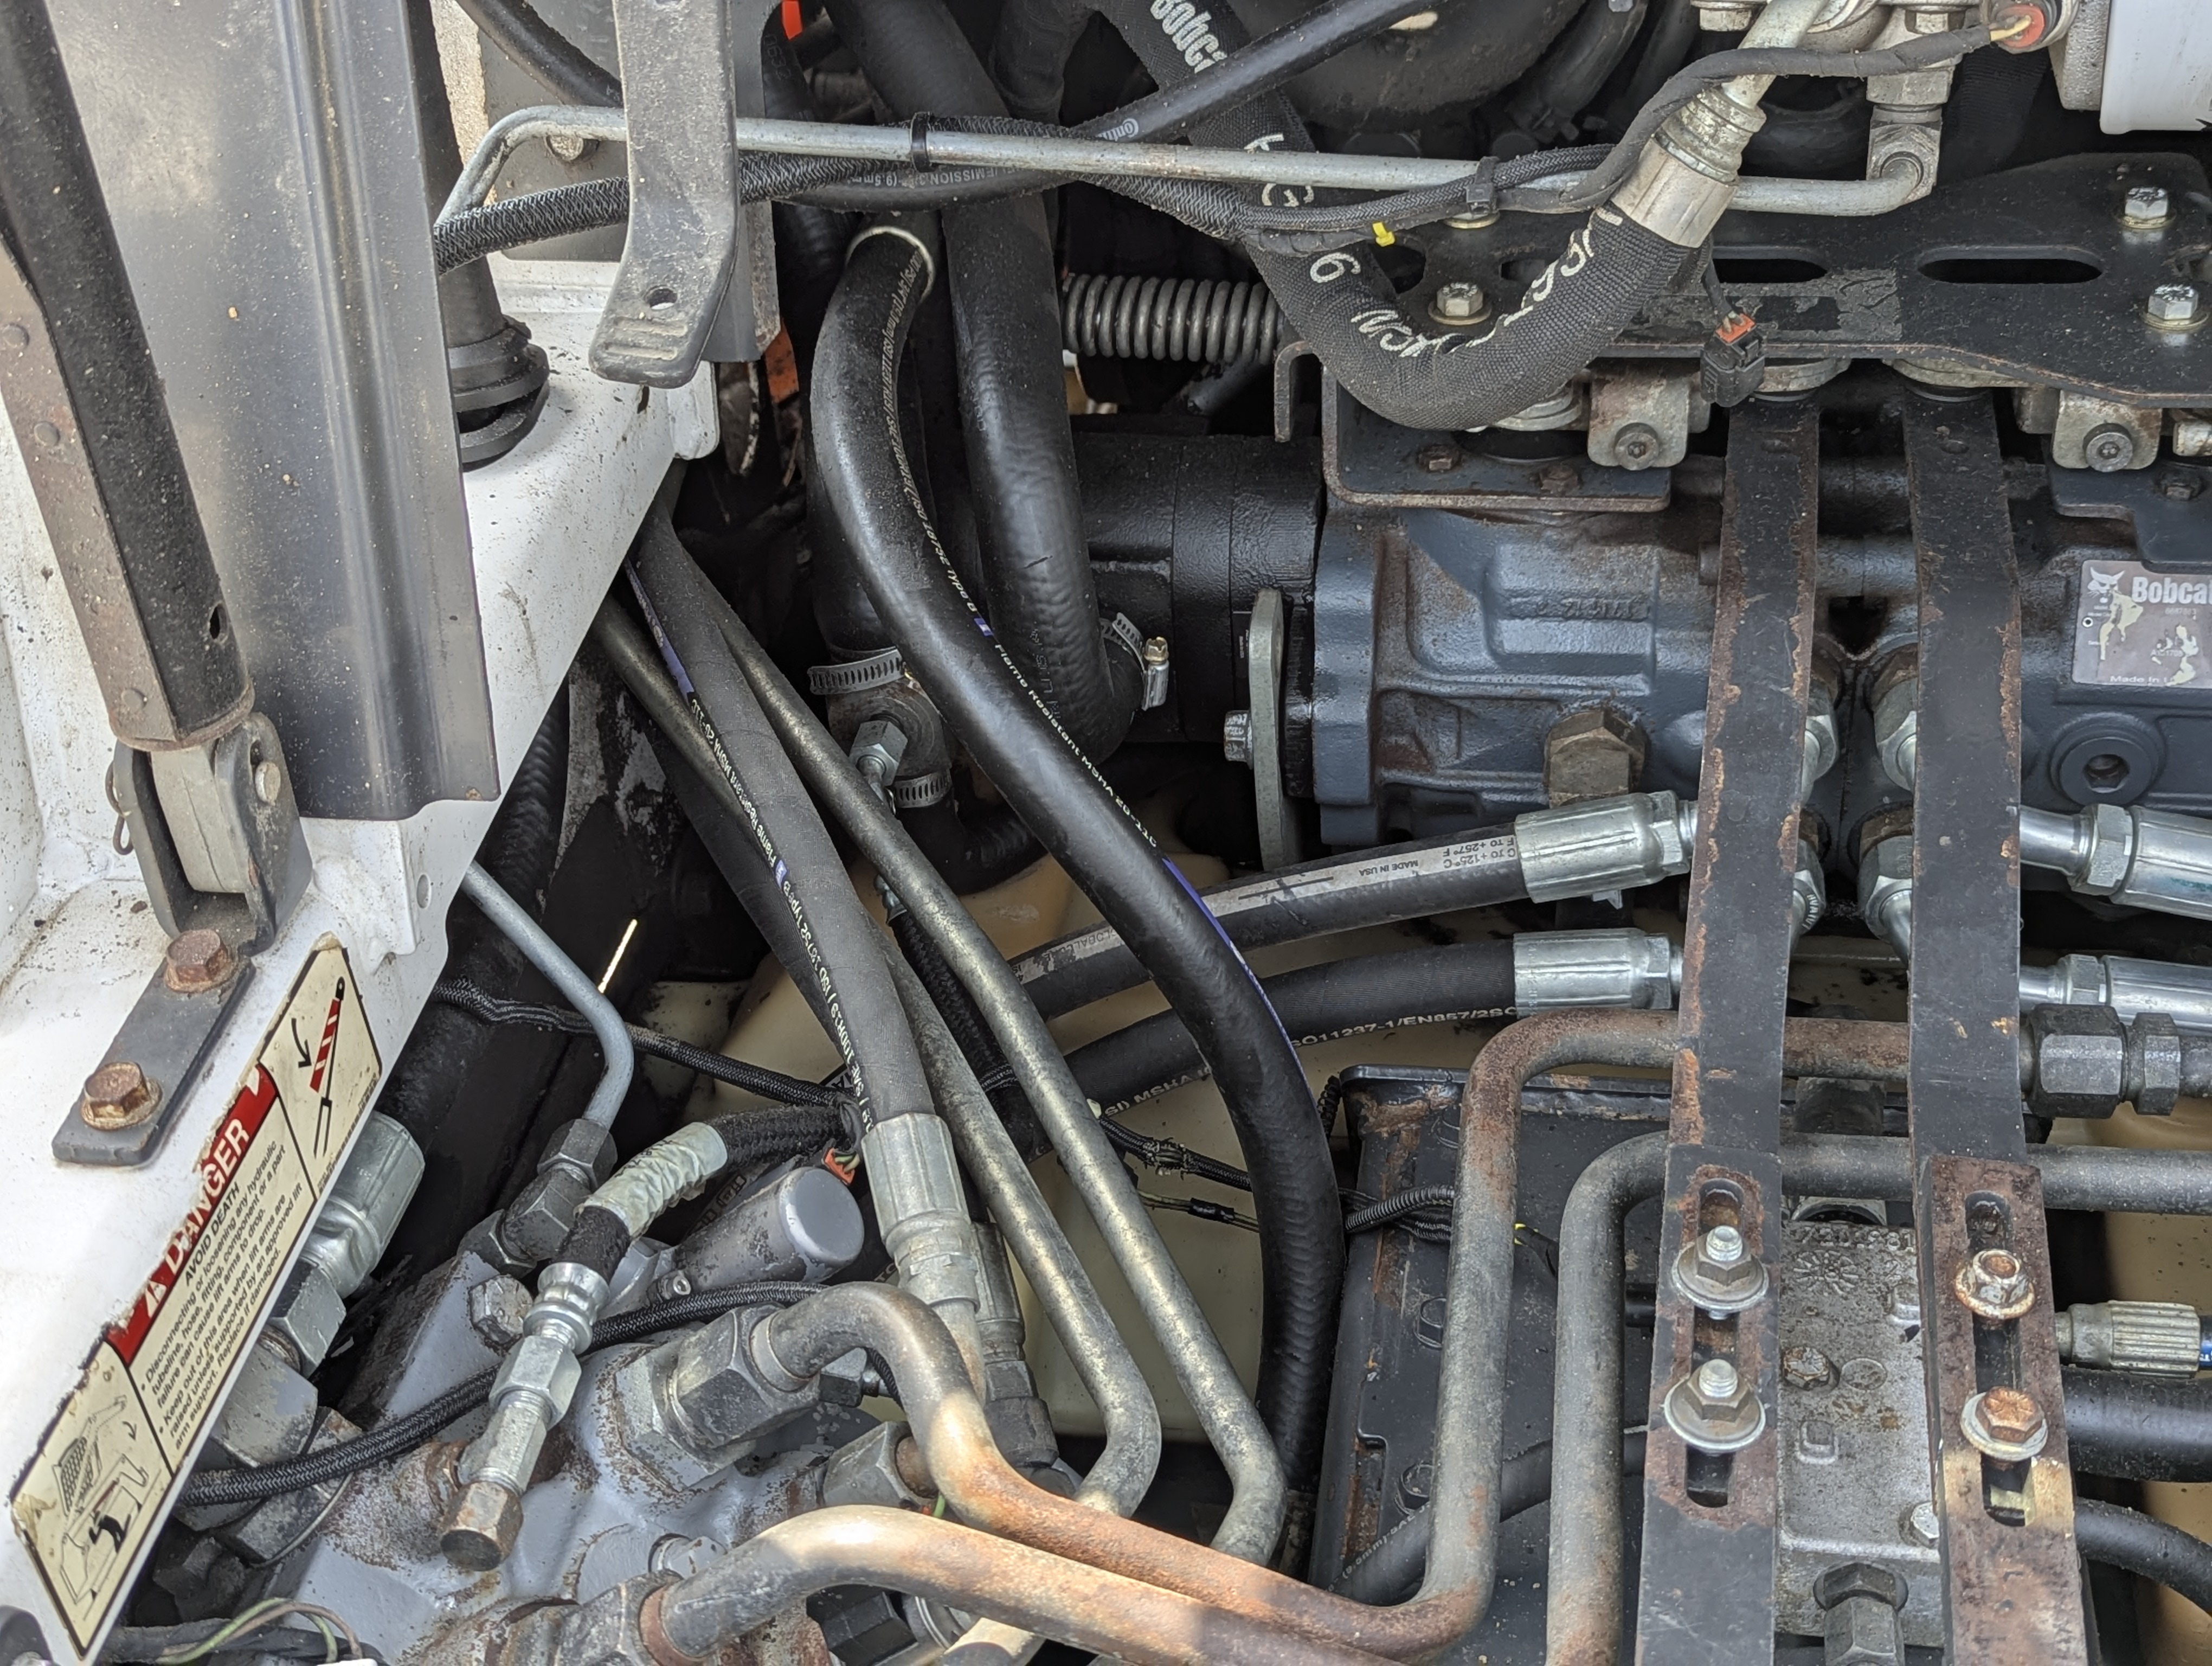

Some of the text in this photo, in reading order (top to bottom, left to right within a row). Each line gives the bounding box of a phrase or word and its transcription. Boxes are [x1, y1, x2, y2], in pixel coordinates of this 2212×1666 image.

[882, 354, 892, 388] 11237
[883, 386, 894, 412] R19
[886, 416, 899, 439] SAE
[911, 497, 928, 520] ISO
[922, 522, 950, 566] 18752
[947, 569, 969, 599] Type
[995, 644, 1028, 688] Flame
[1028, 690, 1079, 756] Resistant
[714, 738, 732, 778] MSHA
[1082, 755, 1114, 797] MSHA
[730, 771, 758, 830] Resistant
[757, 824, 777, 867] Flame
[1443, 848, 1450, 857] F
[1443, 858, 1453, 869] C
[783, 881, 791, 896] B
[1359, 860, 1419, 876] MADE IN USA
[788, 892, 803, 928] Type
[800, 922, 821, 971] 18752
[819, 967, 832, 996] ISO
[831, 1003, 855, 1064] 100R19
[851, 1061, 864, 1097] SAE
[1134, 1075, 1196, 1103] MSHA
[165, 1118, 250, 1275] DANGER
[185, 1181, 240, 1286] AVOID DEATH
[145, 1140, 276, 1383] Disconnecting or loosening any hydraulic
[152, 1144, 286, 1395] tubeline, hose, fitting, component or a part
[157, 1208, 266, 1408] failure can cause lift arms to drop.
[163, 1194, 285, 1426] Keep out of this area when lift arms are
[170, 1182, 303, 1438] raised unless supported by an approved lift
[176, 1247, 279, 1450] arm support. Replace if damaged.
